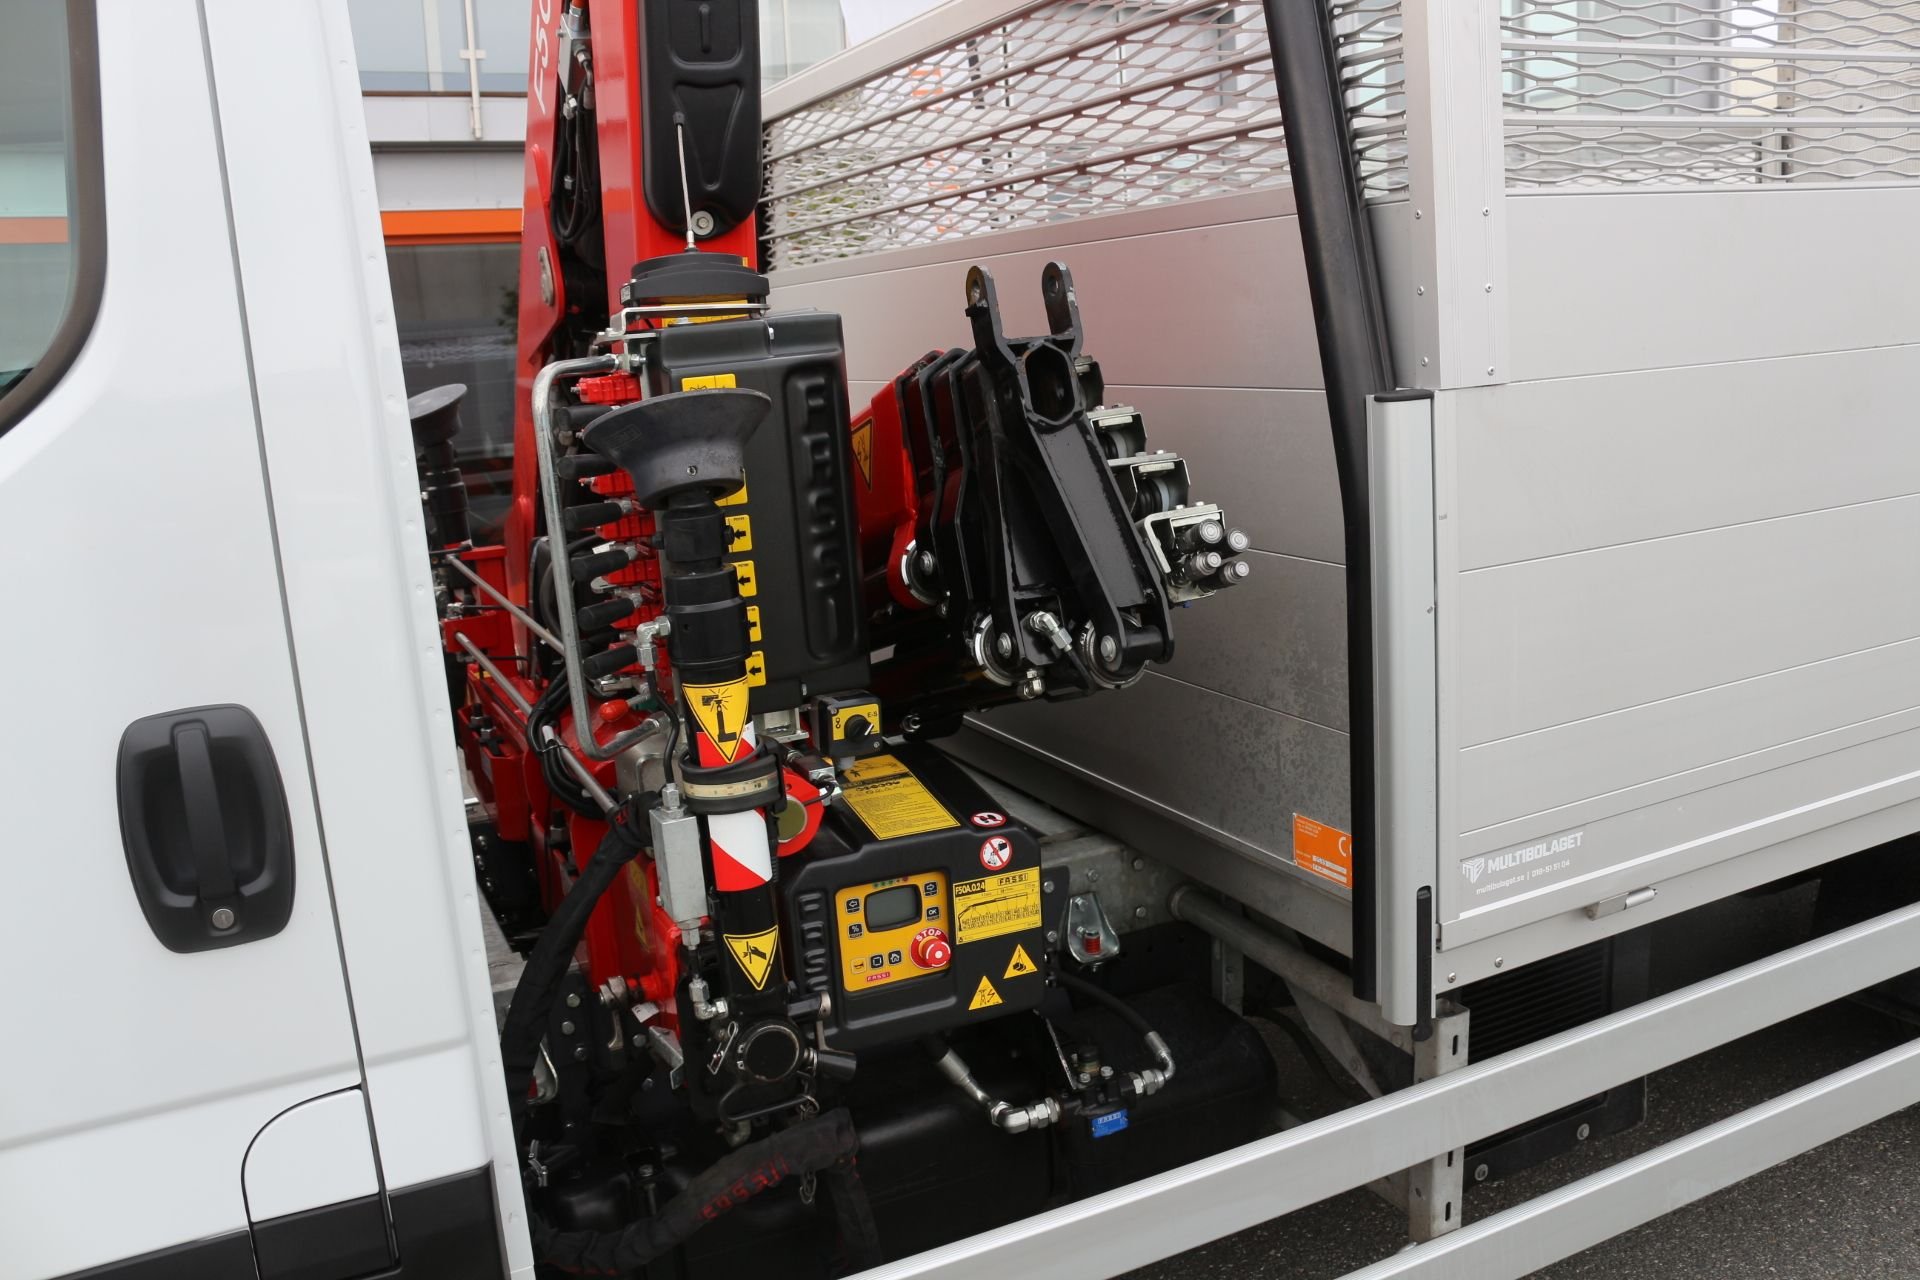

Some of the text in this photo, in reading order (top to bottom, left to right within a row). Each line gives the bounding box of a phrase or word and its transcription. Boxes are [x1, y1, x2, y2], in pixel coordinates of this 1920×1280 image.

[1487, 831, 1584, 873] MULTIBOLAGET
[998, 873, 1028, 886] FASSI
[1476, 874, 1525, 895] multibolaget.se
[915, 928, 942, 942] STOP
